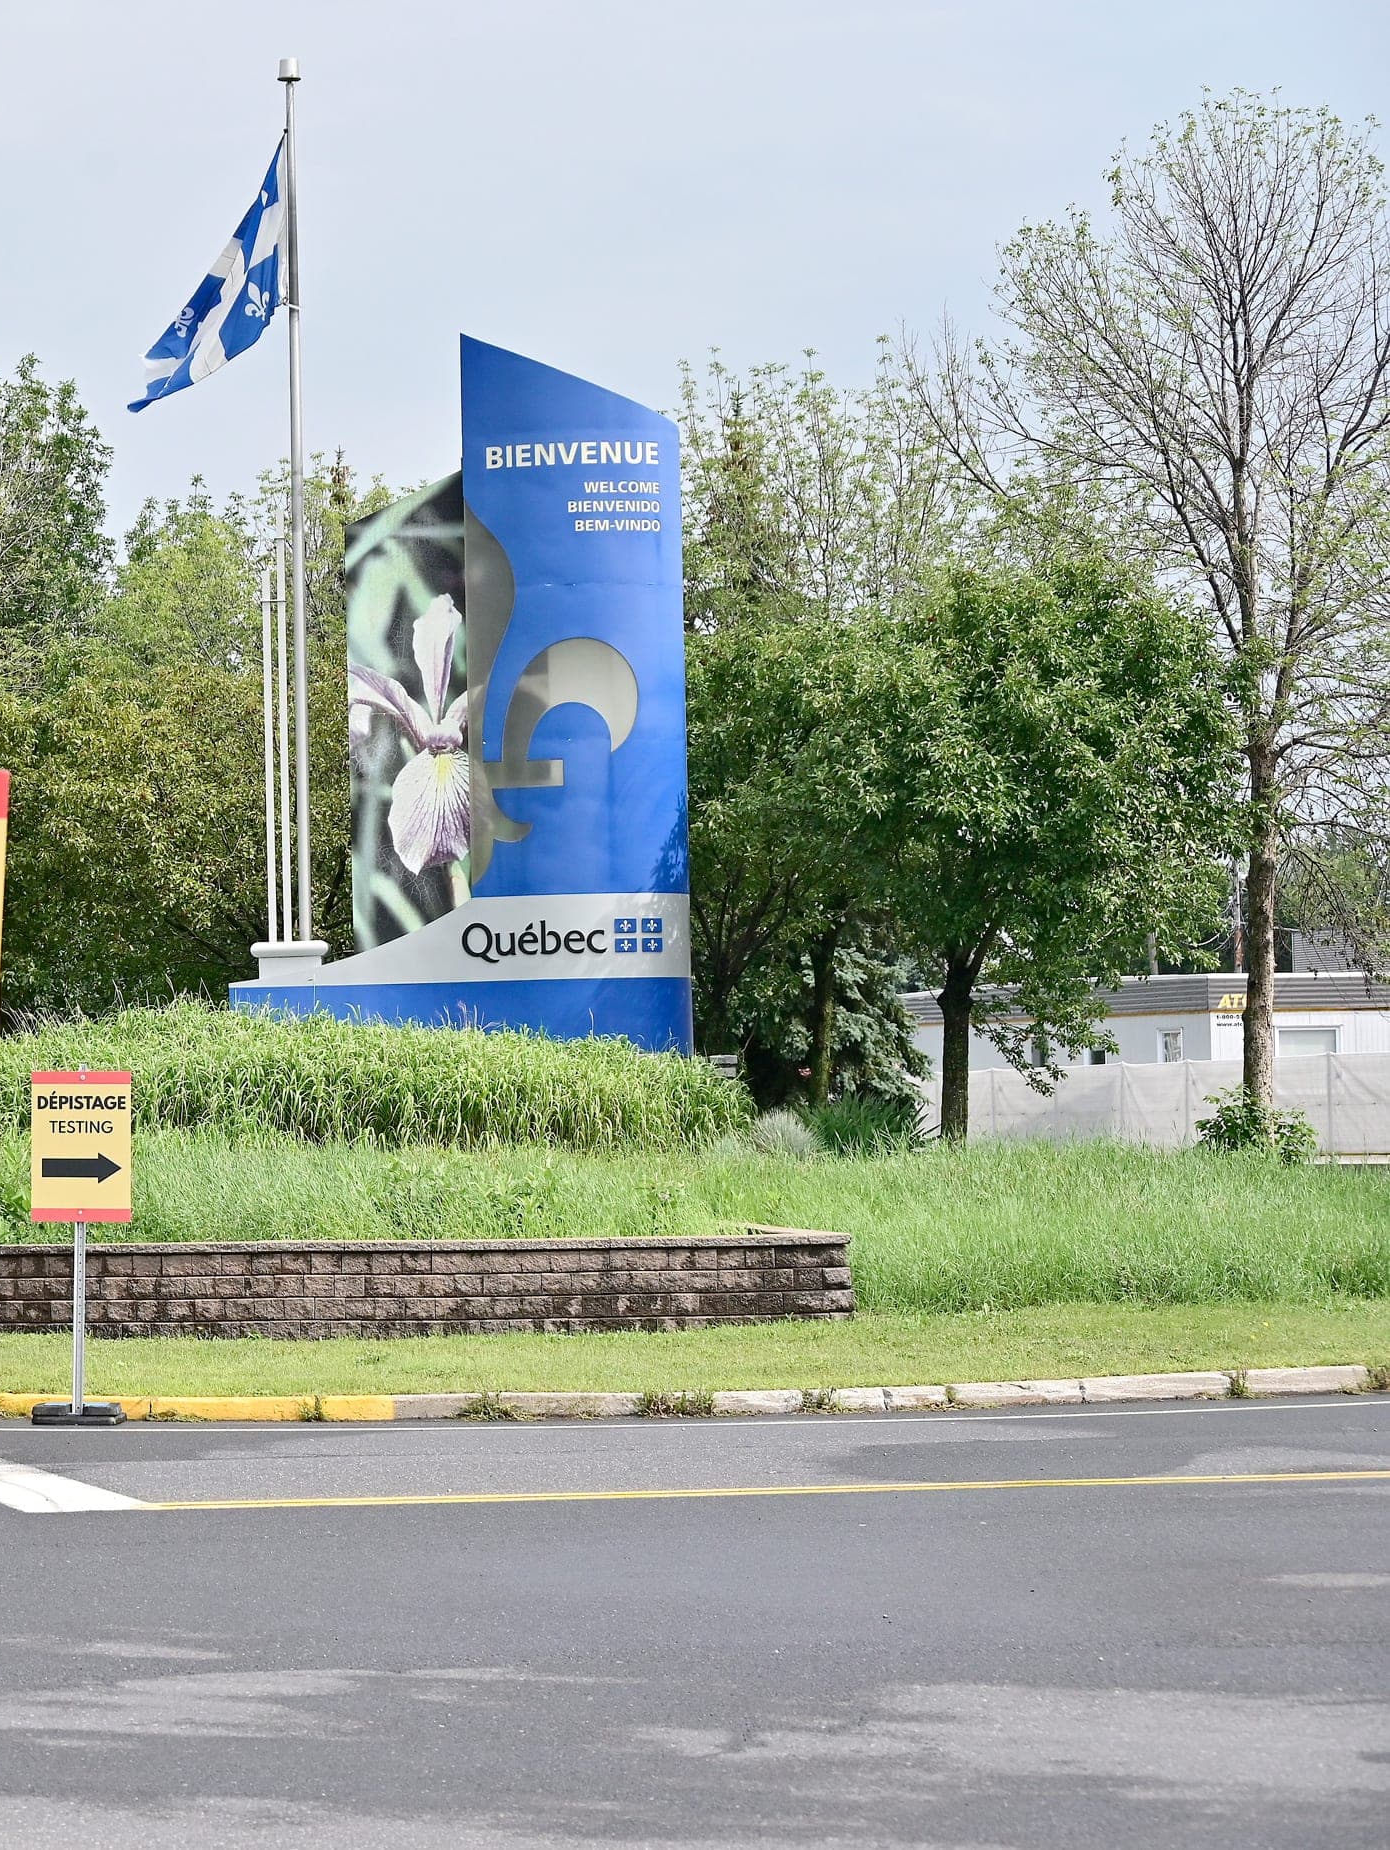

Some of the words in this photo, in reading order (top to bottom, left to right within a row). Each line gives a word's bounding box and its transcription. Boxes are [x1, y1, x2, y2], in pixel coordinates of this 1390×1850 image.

[485, 441, 660, 470] BIENVENUE
[584, 480, 661, 494] WELCOME
[567, 500, 661, 513] BIENVENIDO
[574, 519, 661, 532] BEM-VINDO
[461, 919, 608, 964] Québec
[37, 1090, 127, 1110] DÉPISTAGE
[49, 1120, 114, 1134] TESTING
